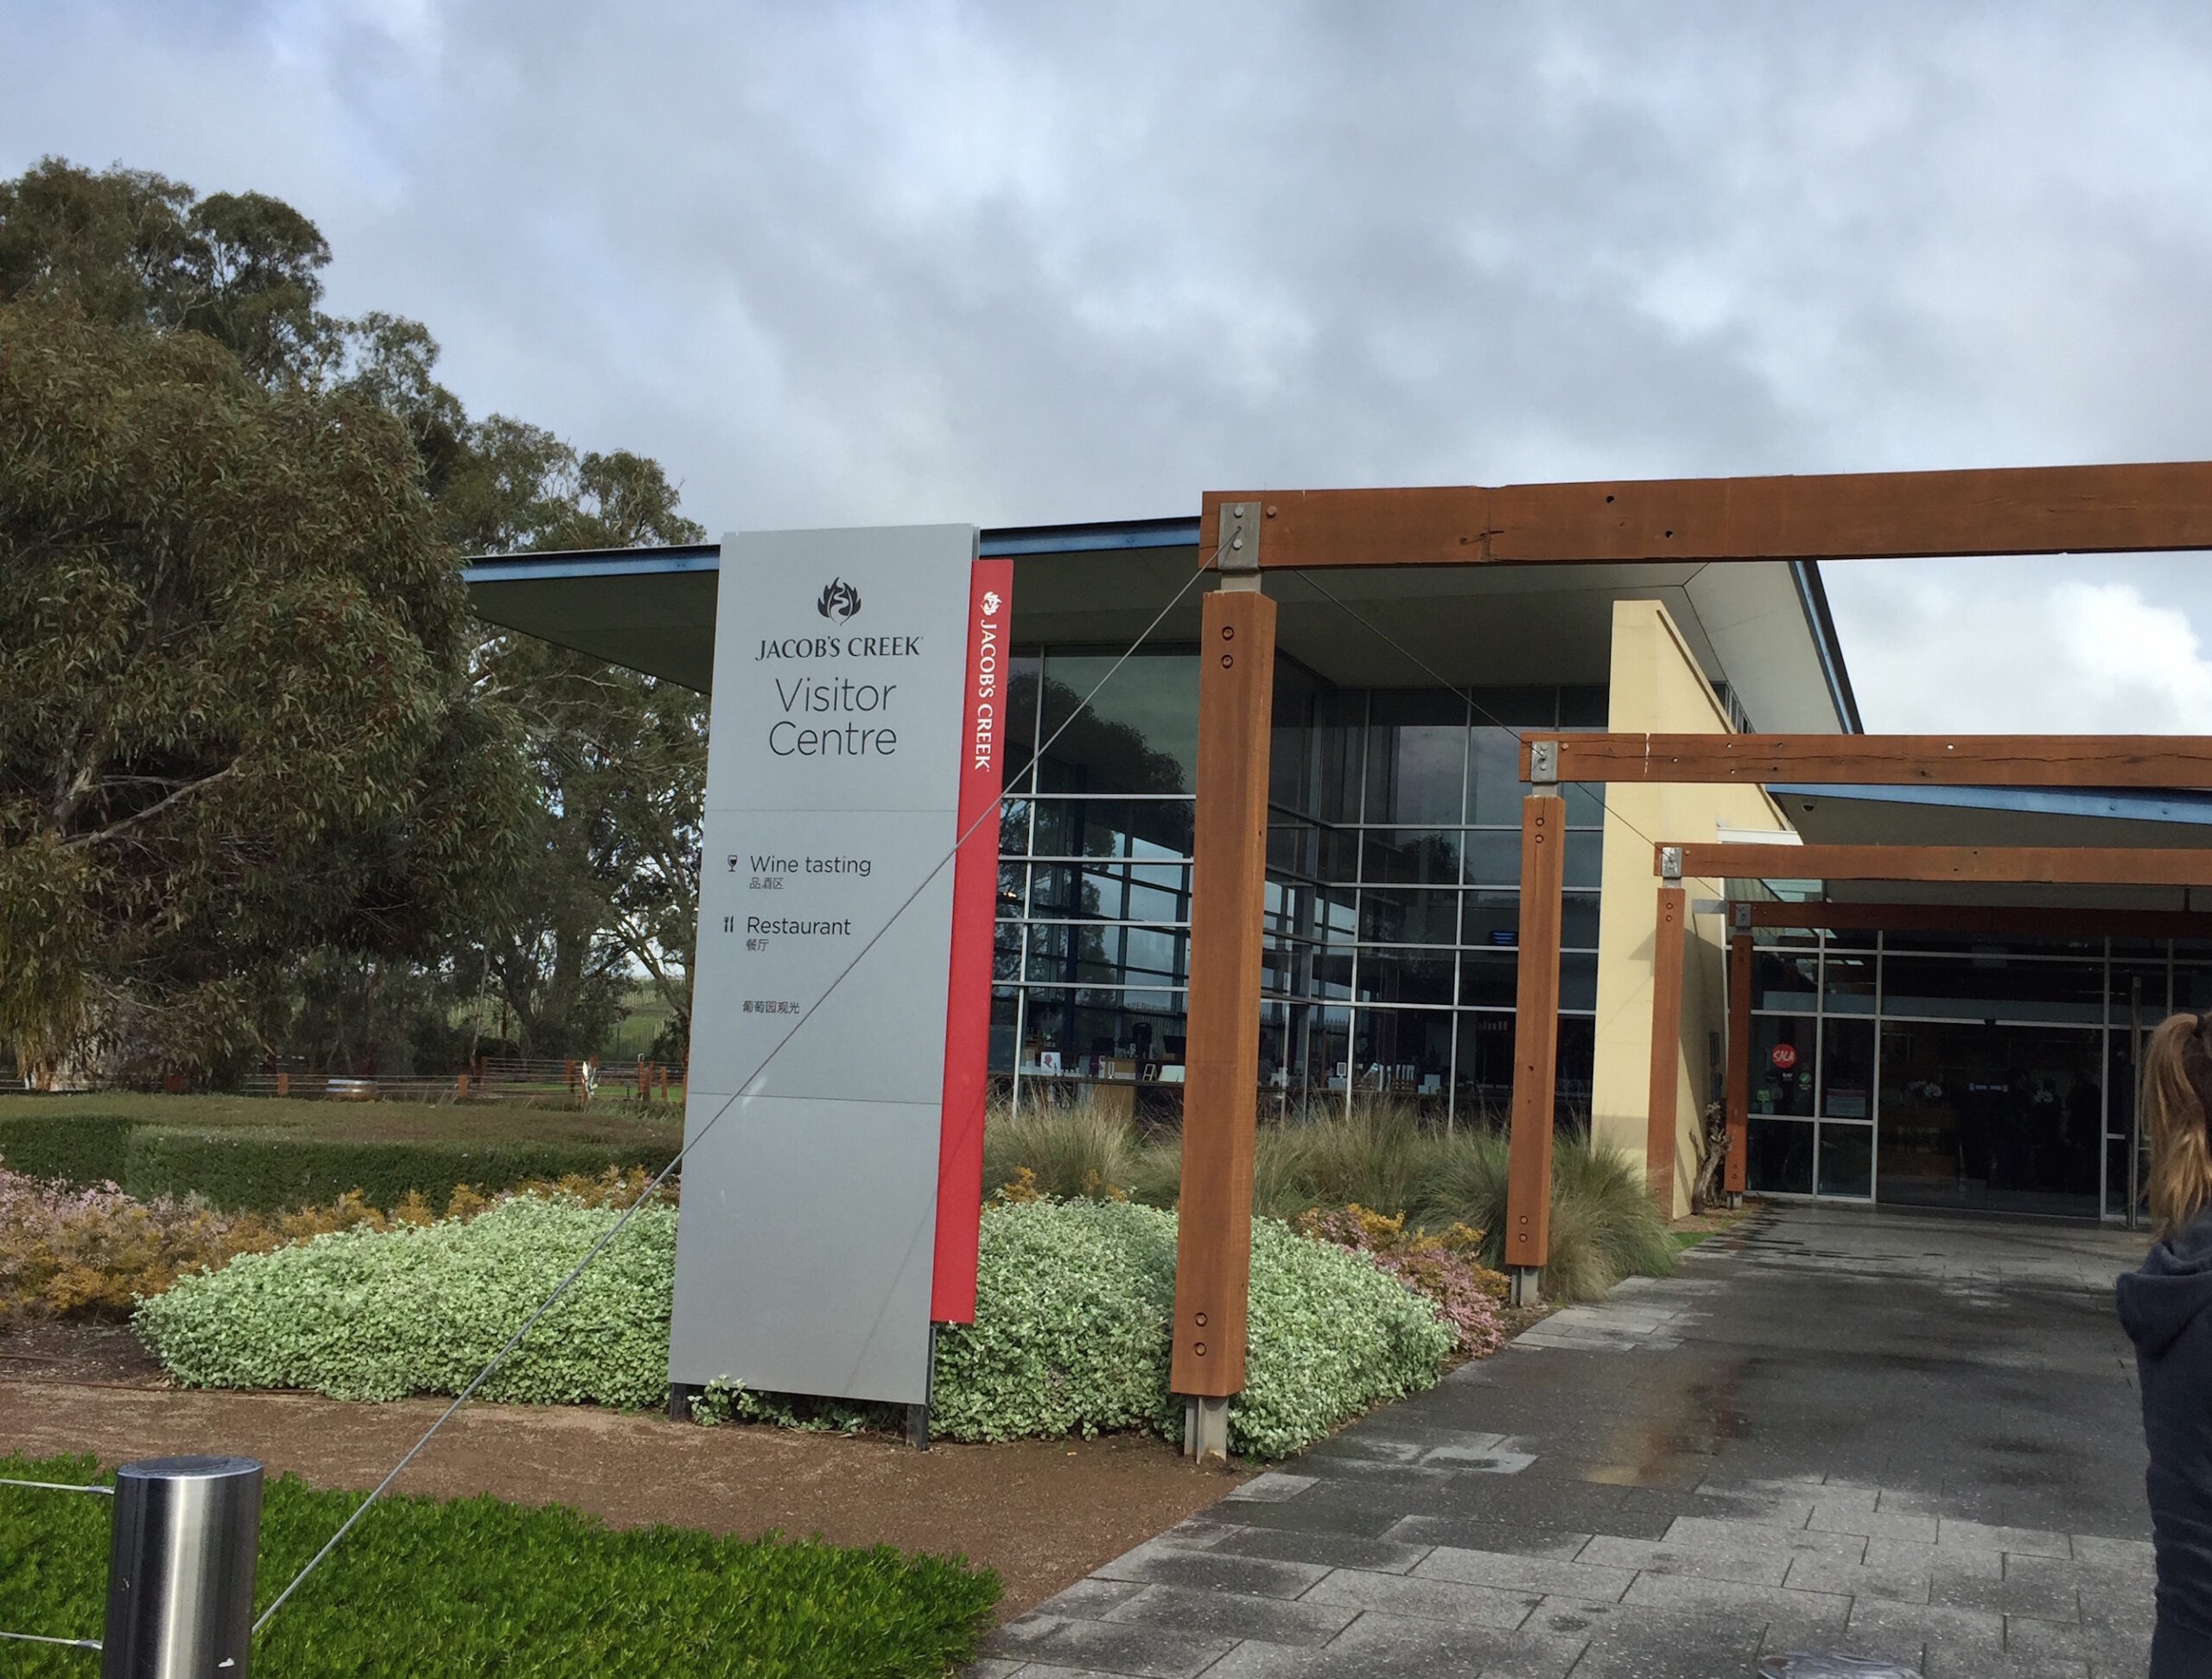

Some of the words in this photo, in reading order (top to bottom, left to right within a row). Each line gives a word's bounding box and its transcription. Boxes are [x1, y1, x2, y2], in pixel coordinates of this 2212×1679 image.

[755, 636, 841, 661] JACOB'S
[848, 637, 921, 657] CREEK
[978, 620, 997, 698] JACOB'S
[775, 677, 897, 713] Visitor
[769, 721, 897, 756] Centre
[975, 704, 994, 771] CREEK
[750, 855, 798, 873] Wine
[805, 855, 871, 876] tasting
[749, 877, 784, 889] 品酒区
[747, 917, 851, 935] Restaurant
[746, 938, 769, 951] 餐厅
